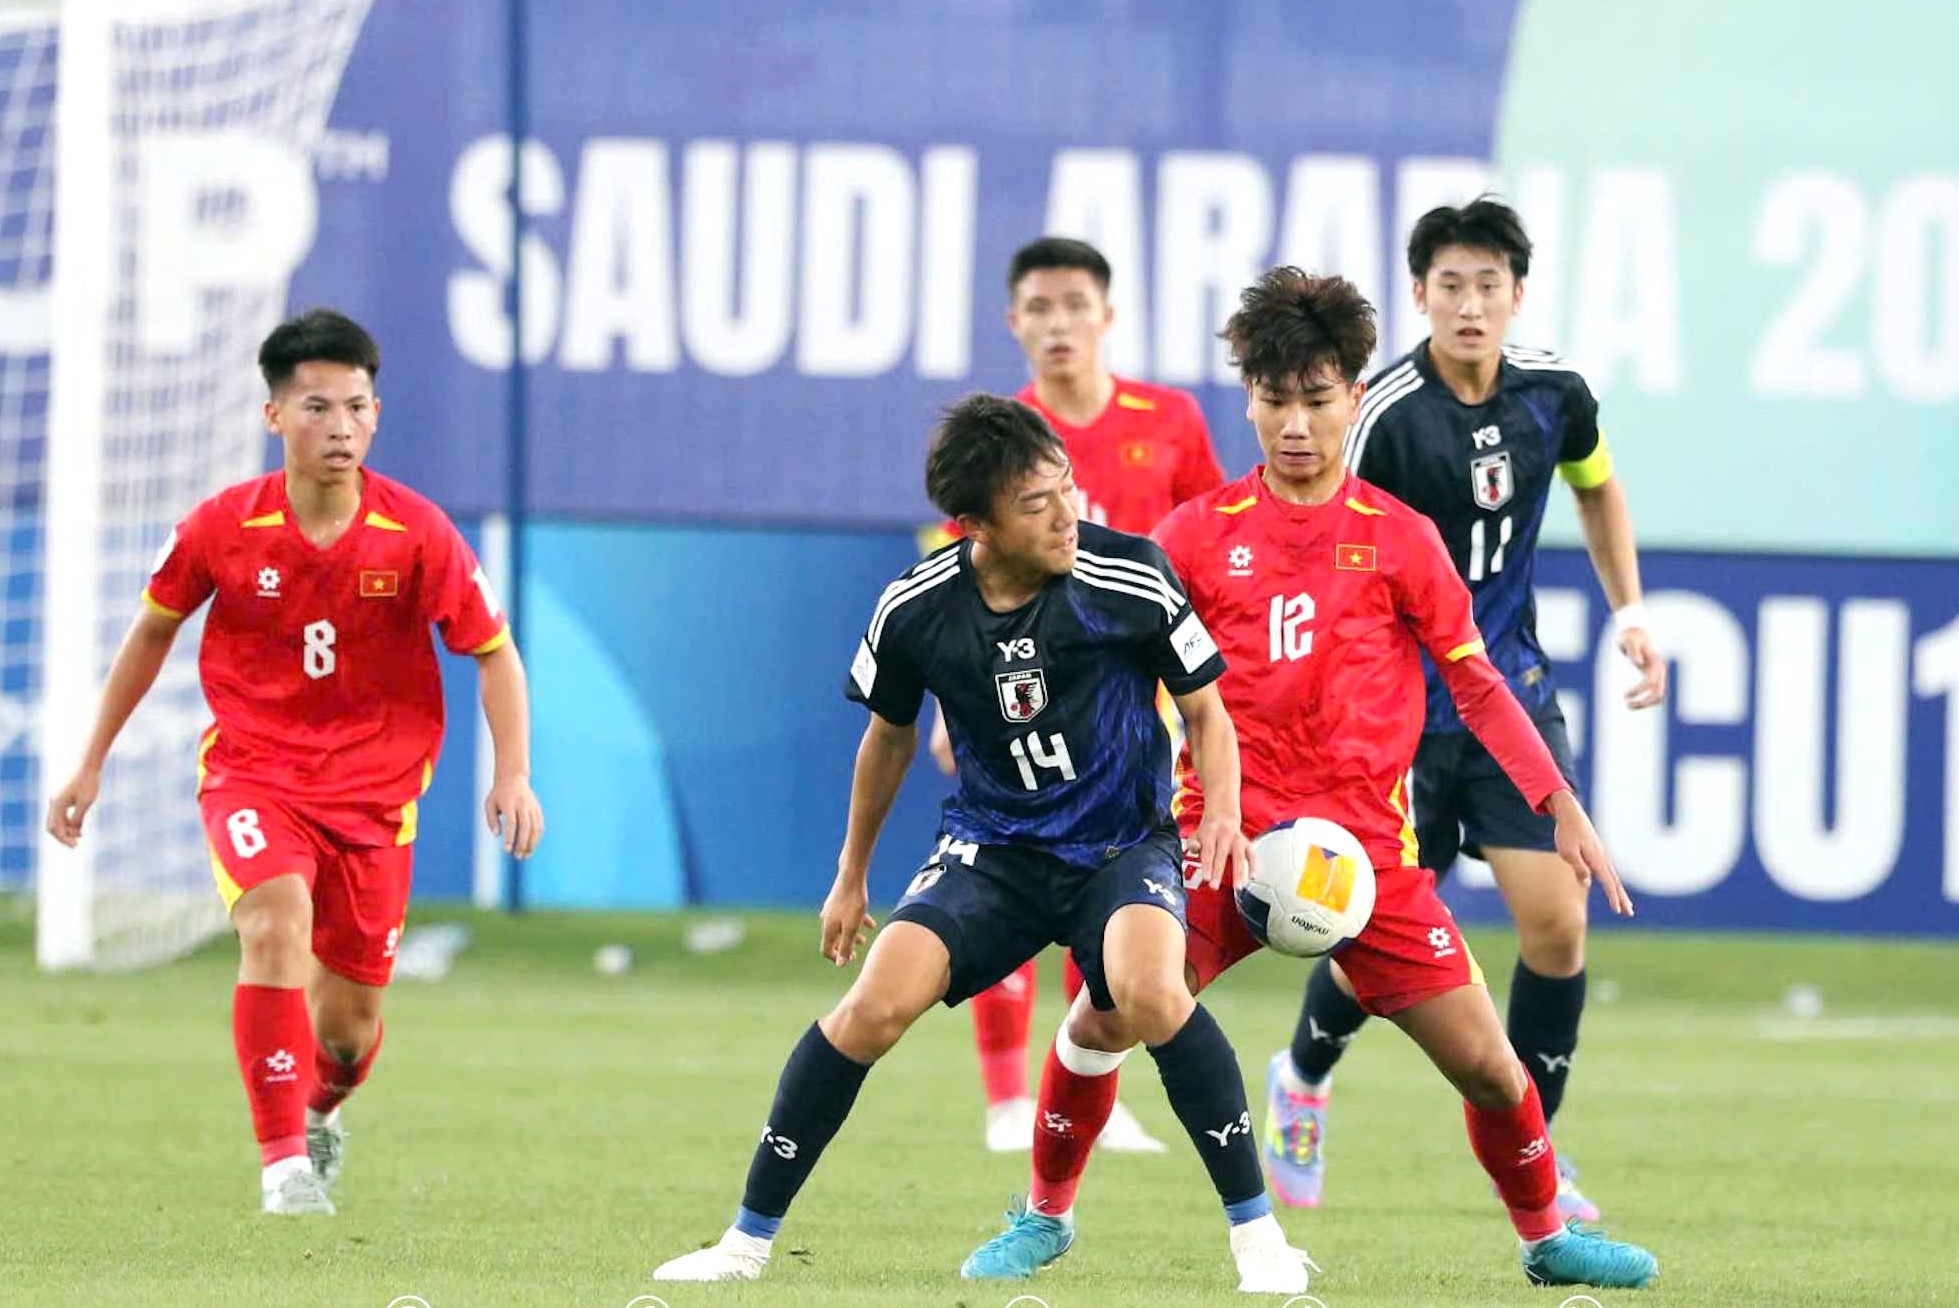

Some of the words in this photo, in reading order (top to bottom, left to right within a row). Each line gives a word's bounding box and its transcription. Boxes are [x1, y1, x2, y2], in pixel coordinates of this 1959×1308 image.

[446, 132, 977, 380] SAUDI
[1750, 172, 1959, 400] 20
[1469, 516, 1513, 581] 11
[303, 619, 337, 679] 8
[997, 637, 1036, 662] Y-3
[1269, 592, 1316, 663] 12
[1009, 730, 1077, 791] 14
[1455, 587, 1959, 903] CU1
[227, 808, 267, 858] 8
[929, 833, 979, 867] 14
[1206, 1111, 1250, 1147] Y-3
